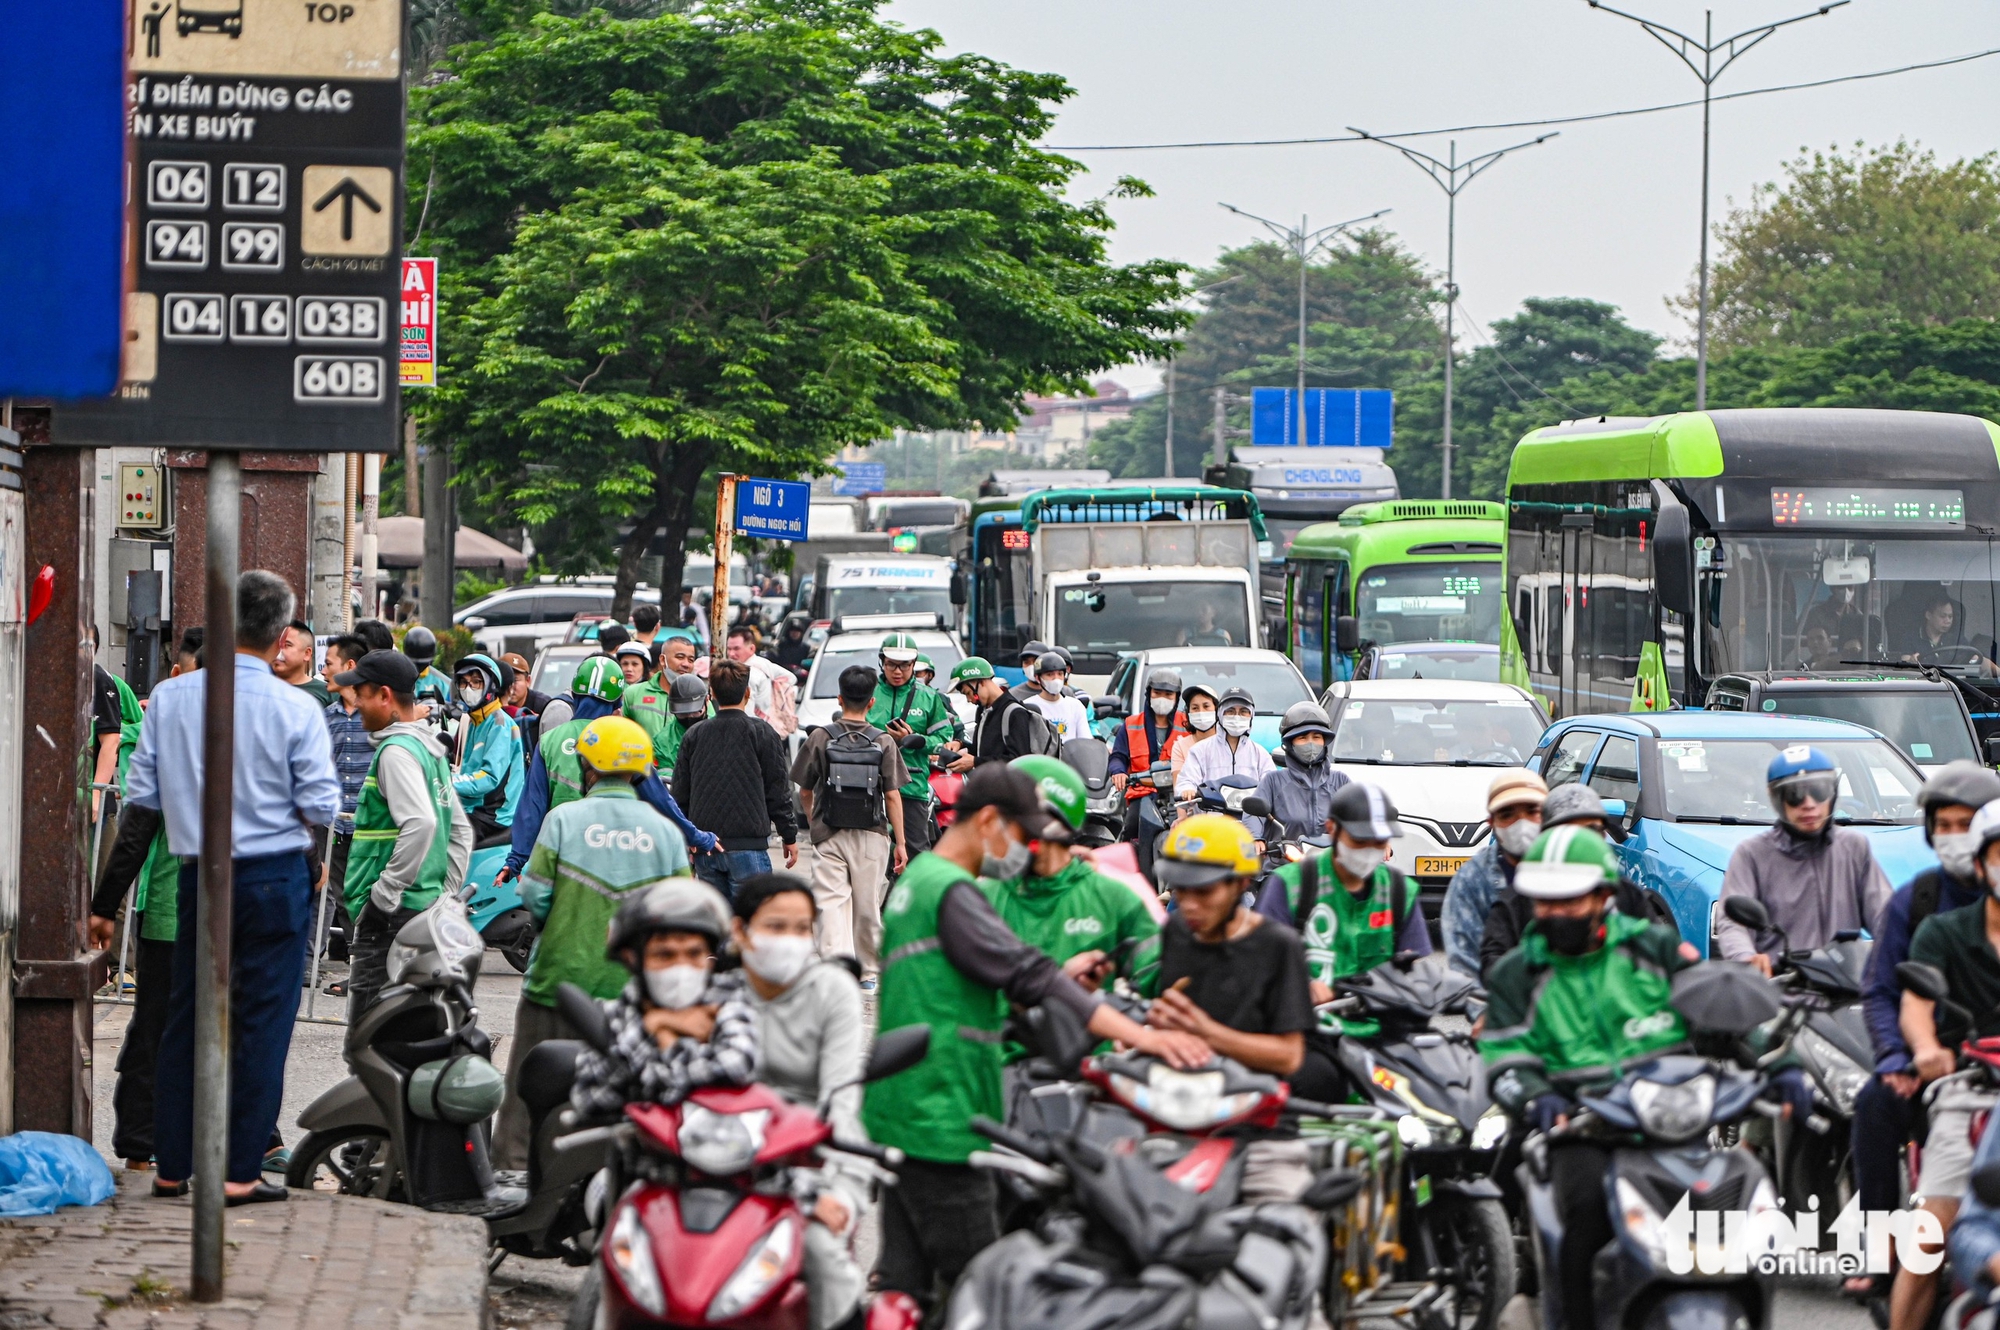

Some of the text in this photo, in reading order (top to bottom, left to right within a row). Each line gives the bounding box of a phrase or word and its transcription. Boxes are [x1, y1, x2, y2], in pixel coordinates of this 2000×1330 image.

[152, 75, 213, 109] ĐIỂM
[218, 80, 289, 110] DỪNG
[294, 83, 354, 112] CÁC
[158, 115, 189, 137] XE
[194, 112, 255, 141] BUÝT
[156, 167, 279, 203] 06 12
[153, 224, 279, 262] 94 99
[301, 256, 340, 270] CÁCH
[342, 258, 358, 271] 90
[172, 299, 377, 335] 04 16 03B
[402, 326, 426, 340] SƠN
[122, 382, 150, 398] BẾN
[302, 361, 377, 395] 60B
[1285, 469, 1361, 483] CHENGLONG
[753, 483, 784, 507] NGÕ 3
[742, 513, 767, 529] ĐƯỜNG
[767, 518, 788, 533] NGỌC
[868, 567, 935, 578] TRANSIT
[962, 667, 981, 676] Grab
[584, 823, 654, 853] Grab
